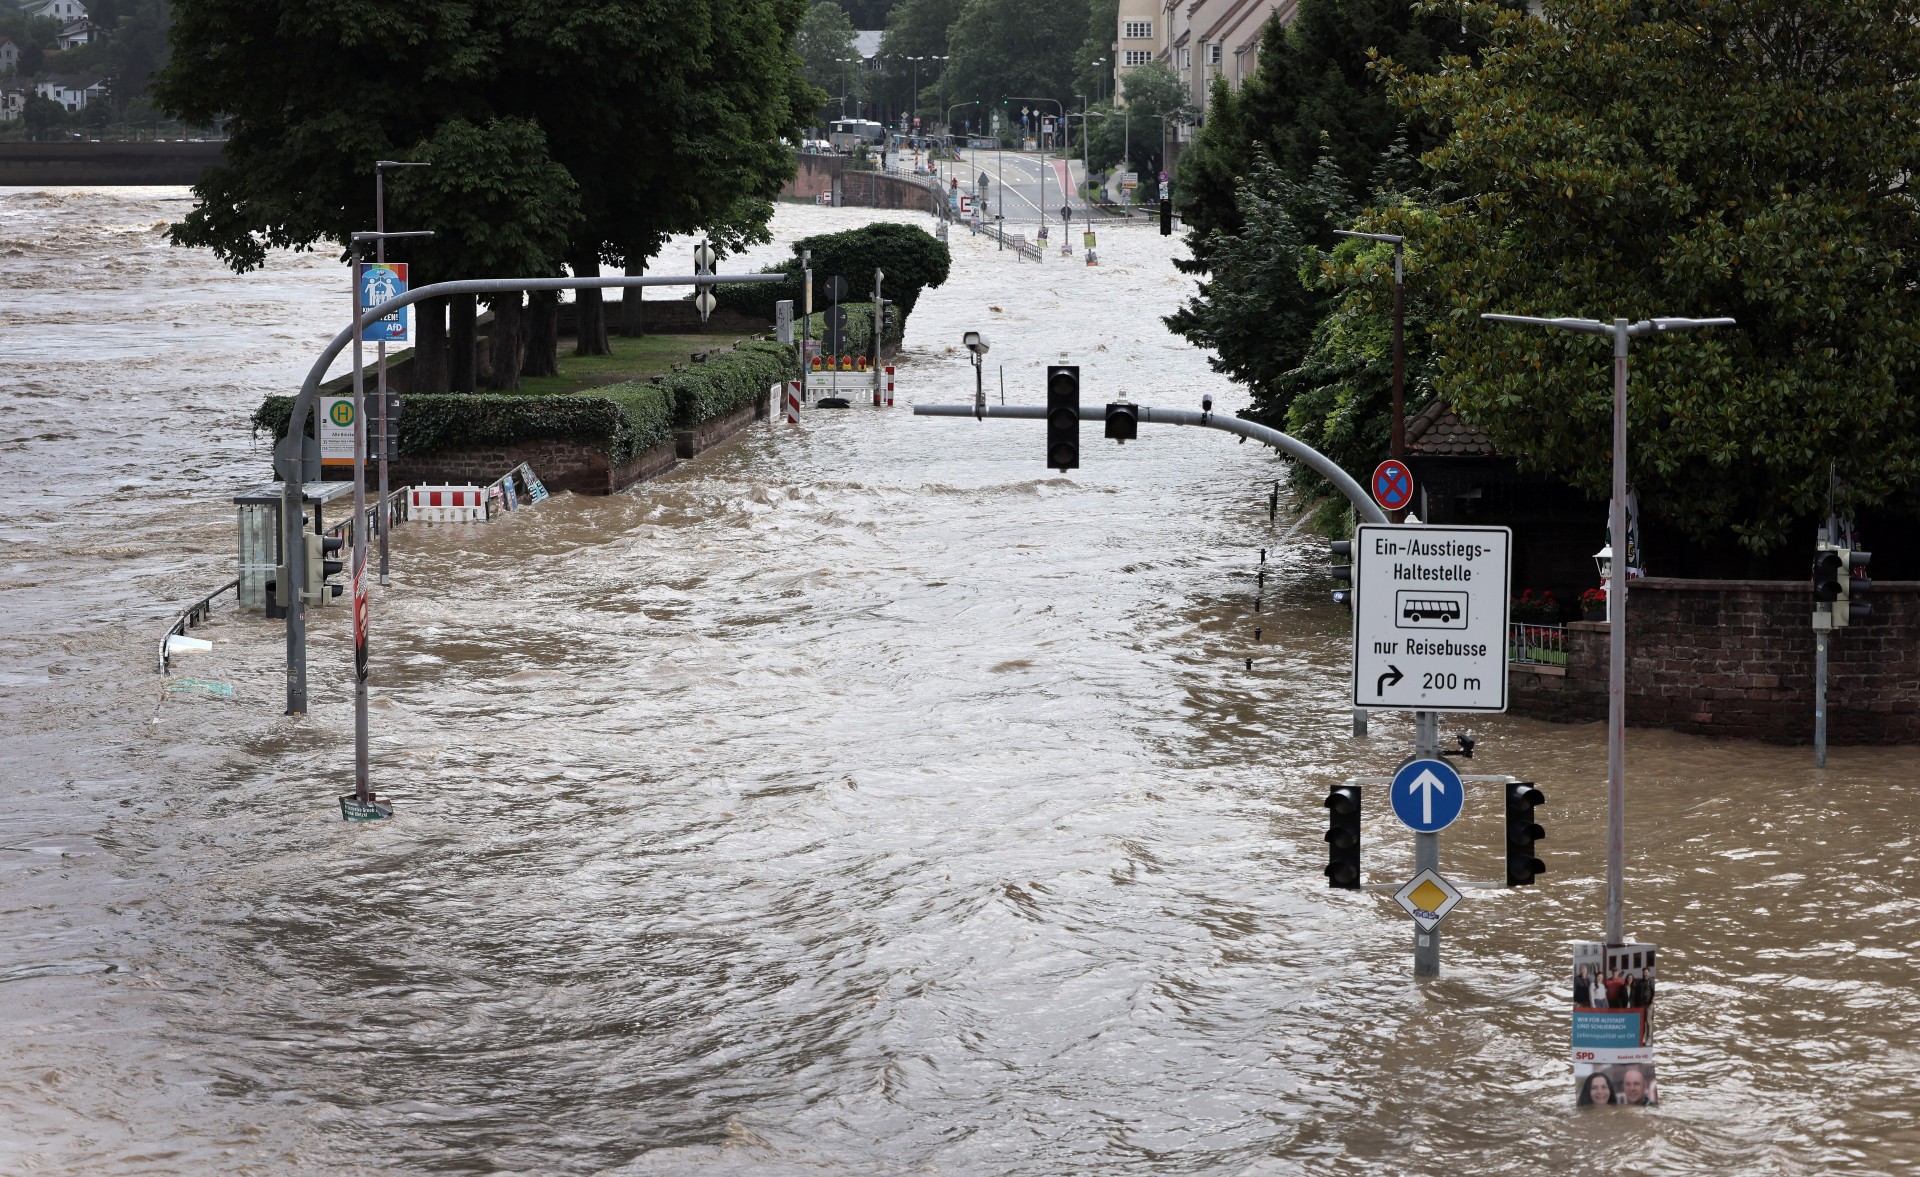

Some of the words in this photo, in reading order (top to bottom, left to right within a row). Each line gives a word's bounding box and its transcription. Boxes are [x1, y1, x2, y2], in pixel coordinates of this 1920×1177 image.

[386, 322, 403, 332] AfD
[337, 406, 348, 421] H
[1375, 538, 1491, 561] Ein-/Ausstiegs-
[1393, 563, 1472, 582] Haltestelle
[1373, 641, 1399, 655] nur
[1406, 638, 1487, 657] Reisebusse
[1422, 672, 1457, 690] 200
[1463, 678, 1481, 691] m
[1576, 1032, 1617, 1040] Lebensqualität
[1576, 1052, 1594, 1060] SPD
